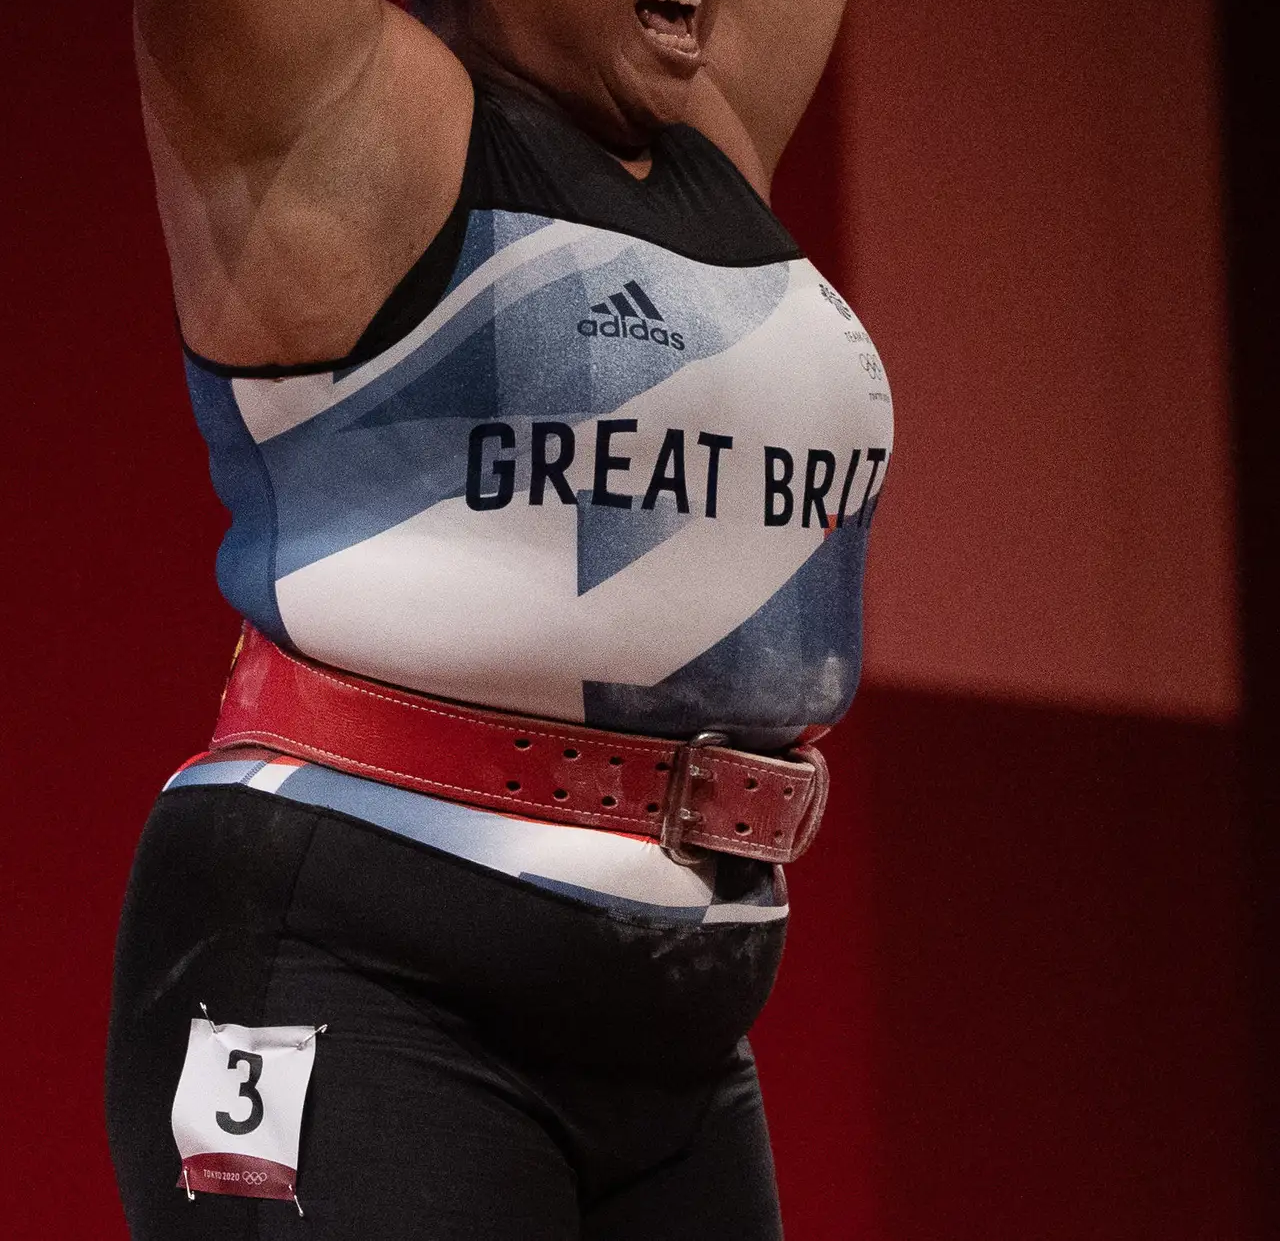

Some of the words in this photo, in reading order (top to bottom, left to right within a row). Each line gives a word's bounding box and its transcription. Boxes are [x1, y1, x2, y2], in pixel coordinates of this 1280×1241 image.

[577, 313, 686, 352] adidas
[465, 419, 733, 519] GREAT
[763, 445, 892, 529] BRIT
[215, 1049, 264, 1135] 3
